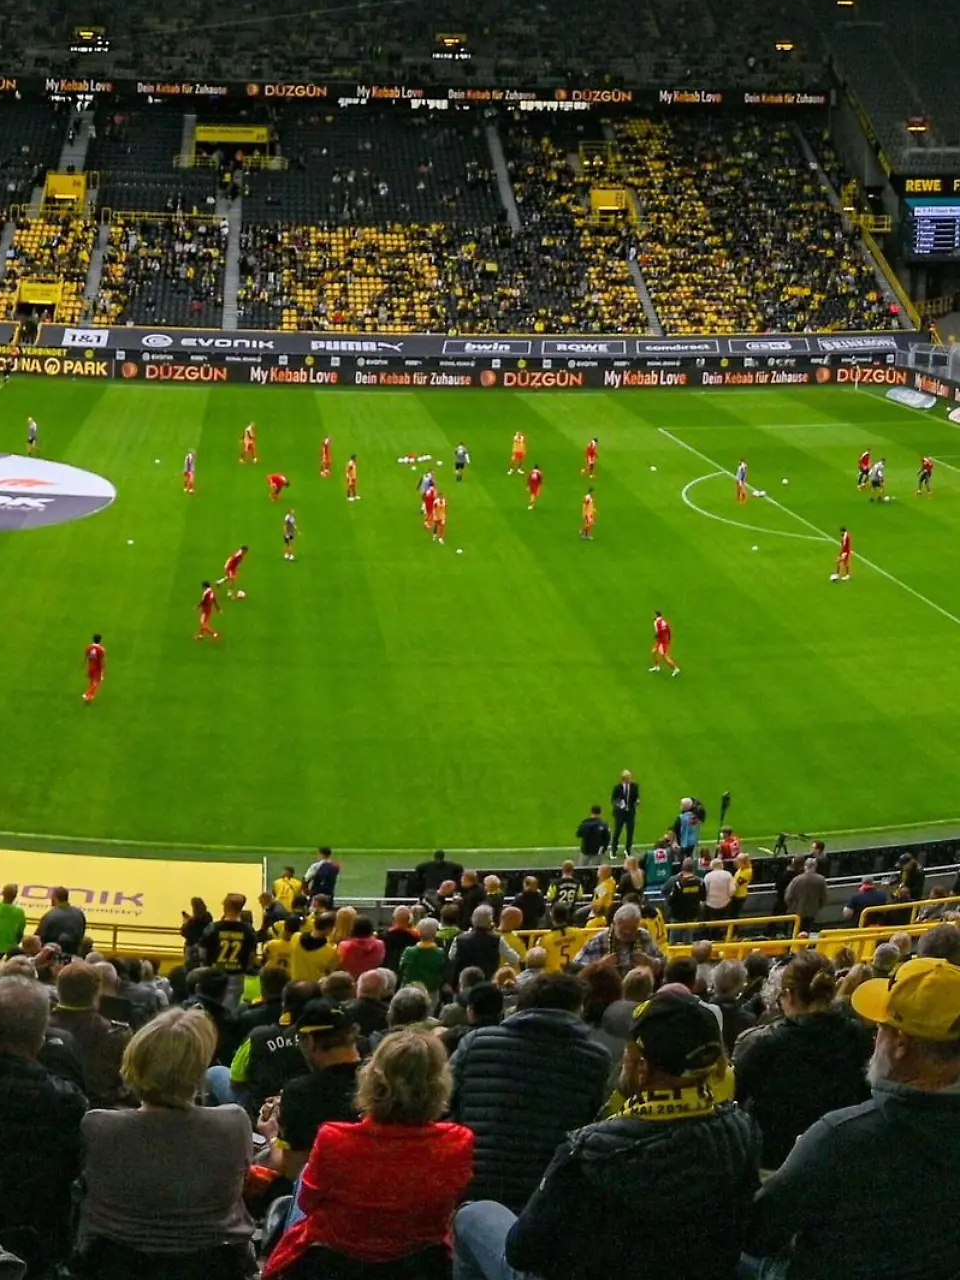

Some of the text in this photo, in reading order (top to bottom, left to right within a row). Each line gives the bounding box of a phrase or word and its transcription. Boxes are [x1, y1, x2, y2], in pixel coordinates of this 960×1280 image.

[46, 79, 59, 93] My
[265, 83, 328, 97] DÜZGÜN
[356, 86, 369, 99] My
[659, 91, 672, 104] My
[905, 179, 942, 192] REWE
[70, 334, 102, 343] 1&1
[181, 338, 275, 349] EVONIK
[63, 358, 108, 377] PARK
[145, 363, 227, 381] DÜZGÜN
[250, 366, 338, 385] My Kebab Love
[355, 370, 472, 387] Dein Kebab für Zuhause
[504, 369, 583, 387] DÜZGÜN
[604, 370, 688, 389] My Kebab Love
[702, 370, 808, 385] Dein Kebab für Zuhause
[836, 367, 907, 385] DÜZGÜN
[217, 941, 242, 963] 22
